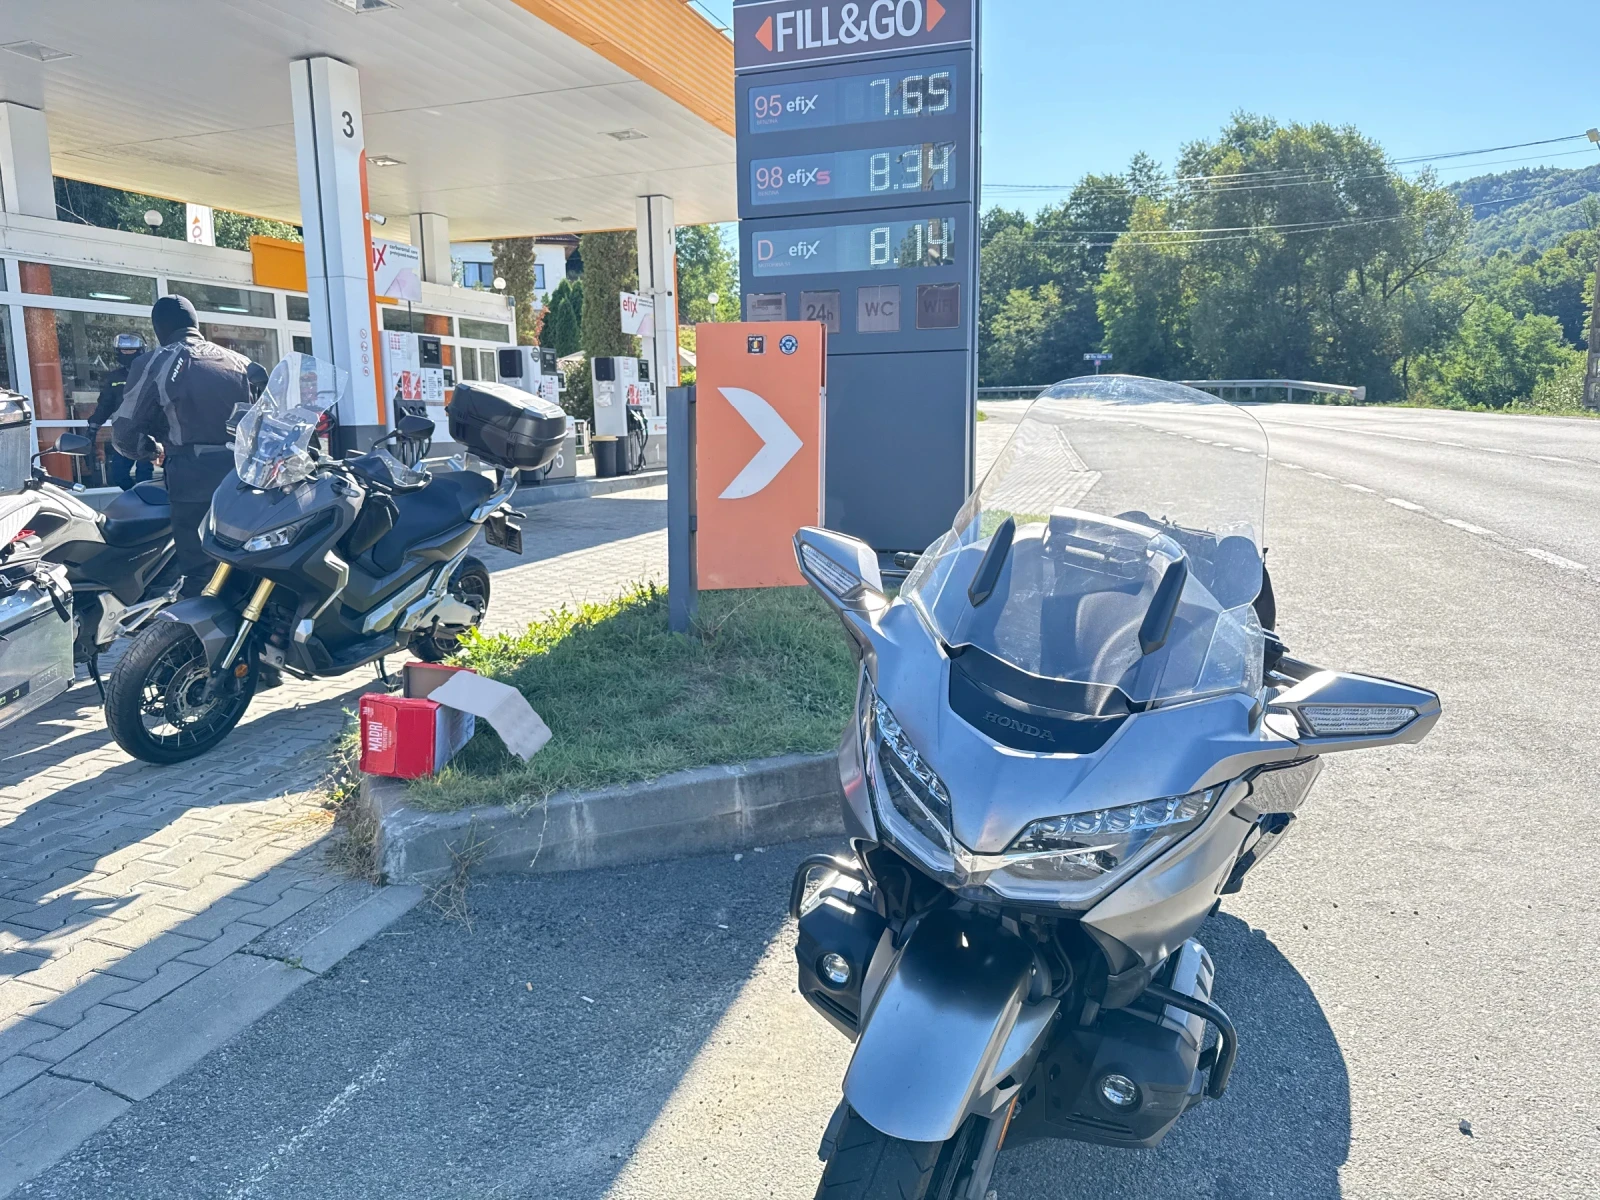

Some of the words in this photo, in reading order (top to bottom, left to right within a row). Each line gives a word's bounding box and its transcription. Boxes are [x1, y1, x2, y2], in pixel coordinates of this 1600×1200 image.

[776, 0, 923, 52] FILL&GO
[754, 94, 782, 118] 95
[787, 95, 818, 114] efix
[869, 71, 949, 116] 7.65
[341, 110, 354, 138] 3
[756, 166, 783, 190] 98
[870, 147, 949, 191] 8.34
[757, 239, 773, 261] D
[789, 241, 820, 258] efix
[870, 222, 948, 265] 8.14
[623, 297, 638, 318] efix
[865, 301, 893, 317] WC
[983, 711, 1055, 742] HONDA
